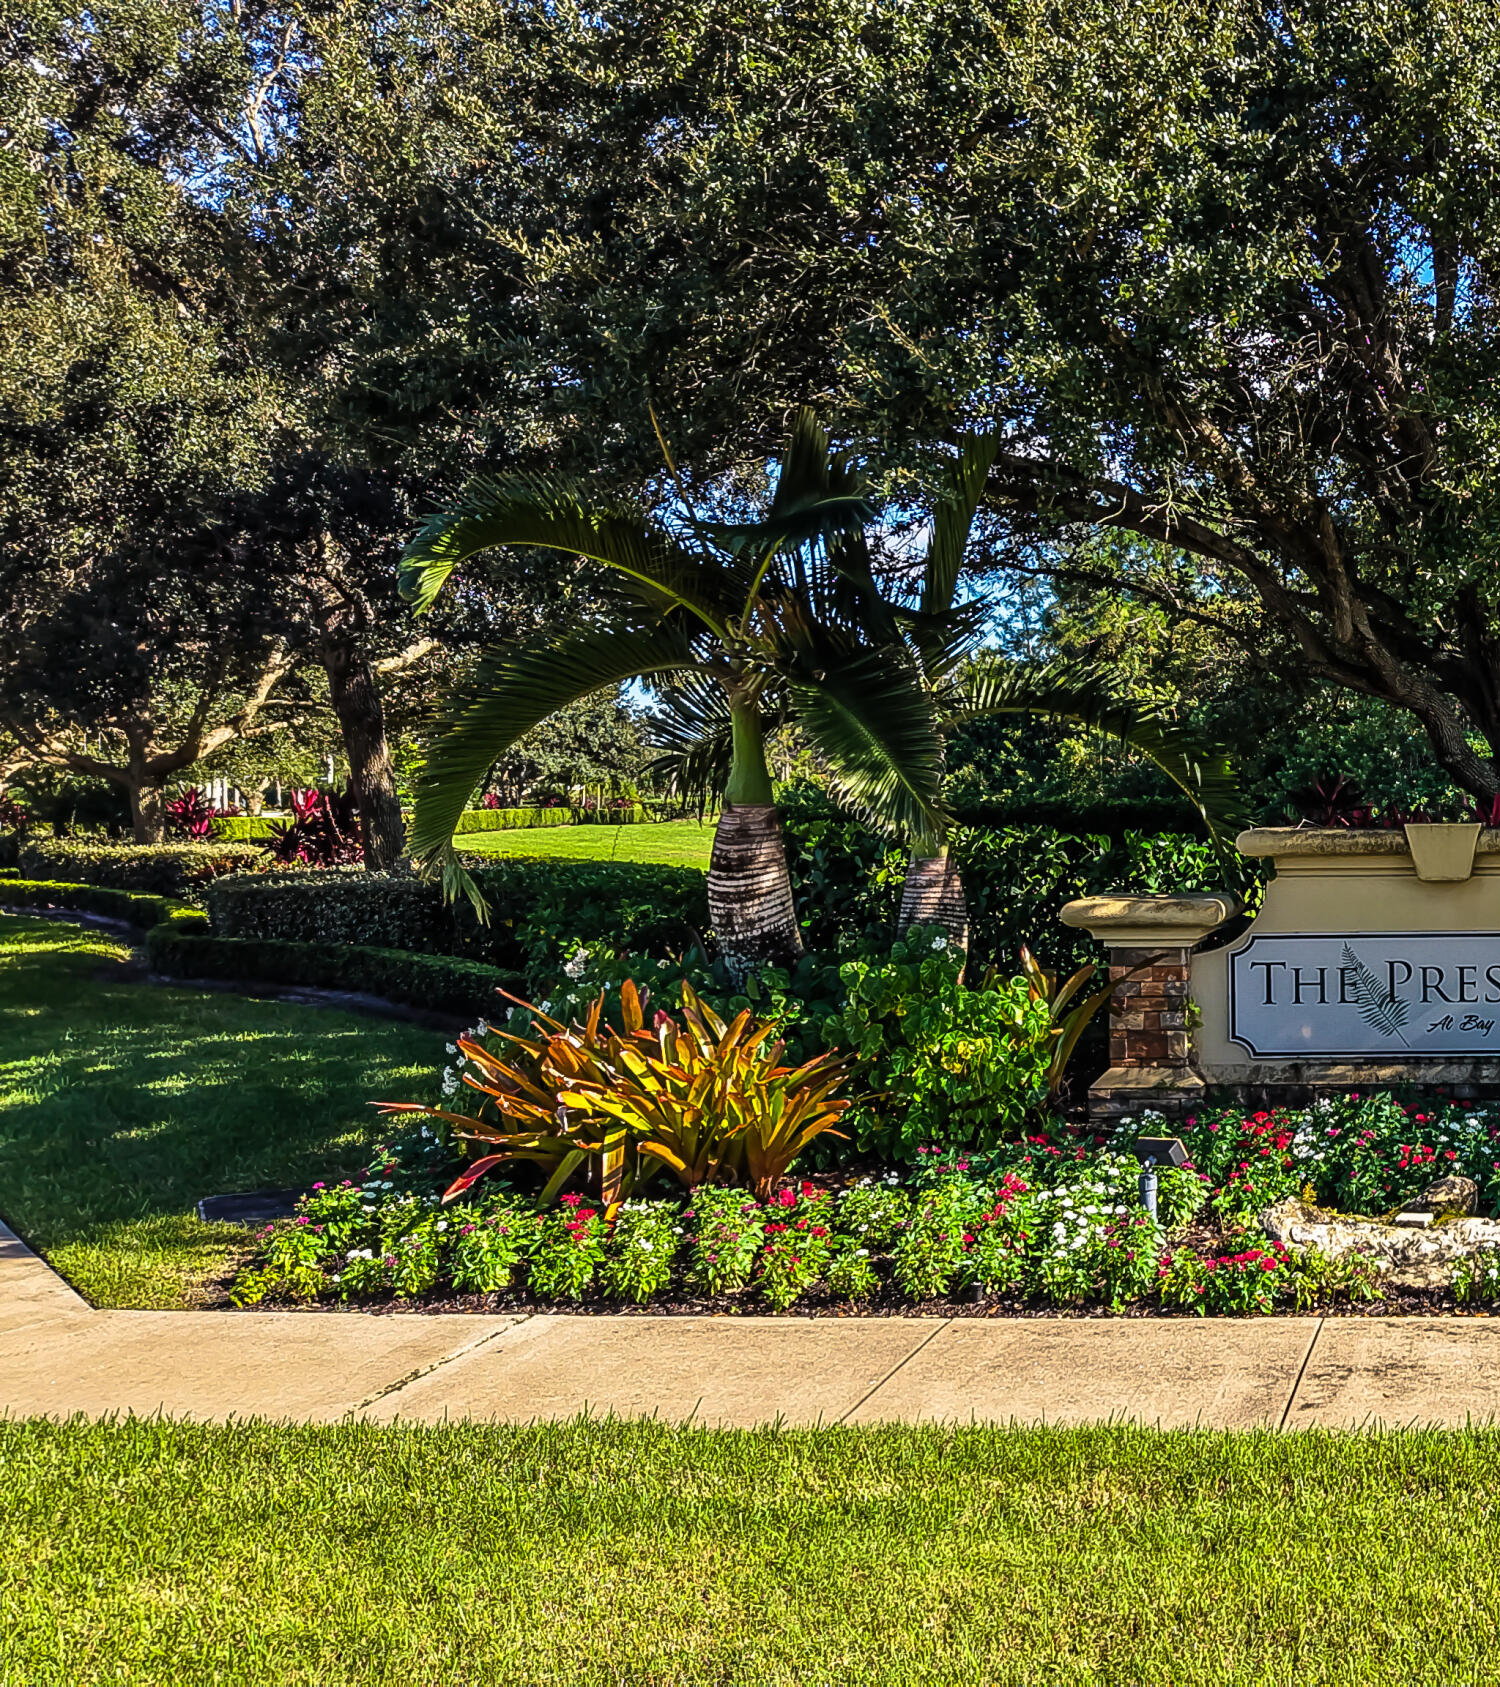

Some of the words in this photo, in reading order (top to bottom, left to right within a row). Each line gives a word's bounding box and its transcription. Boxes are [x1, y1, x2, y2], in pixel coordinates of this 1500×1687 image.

[1250, 961, 1360, 1005] THE
[1426, 1014, 1454, 1032] At
[1459, 1015, 1495, 1037] Bay
